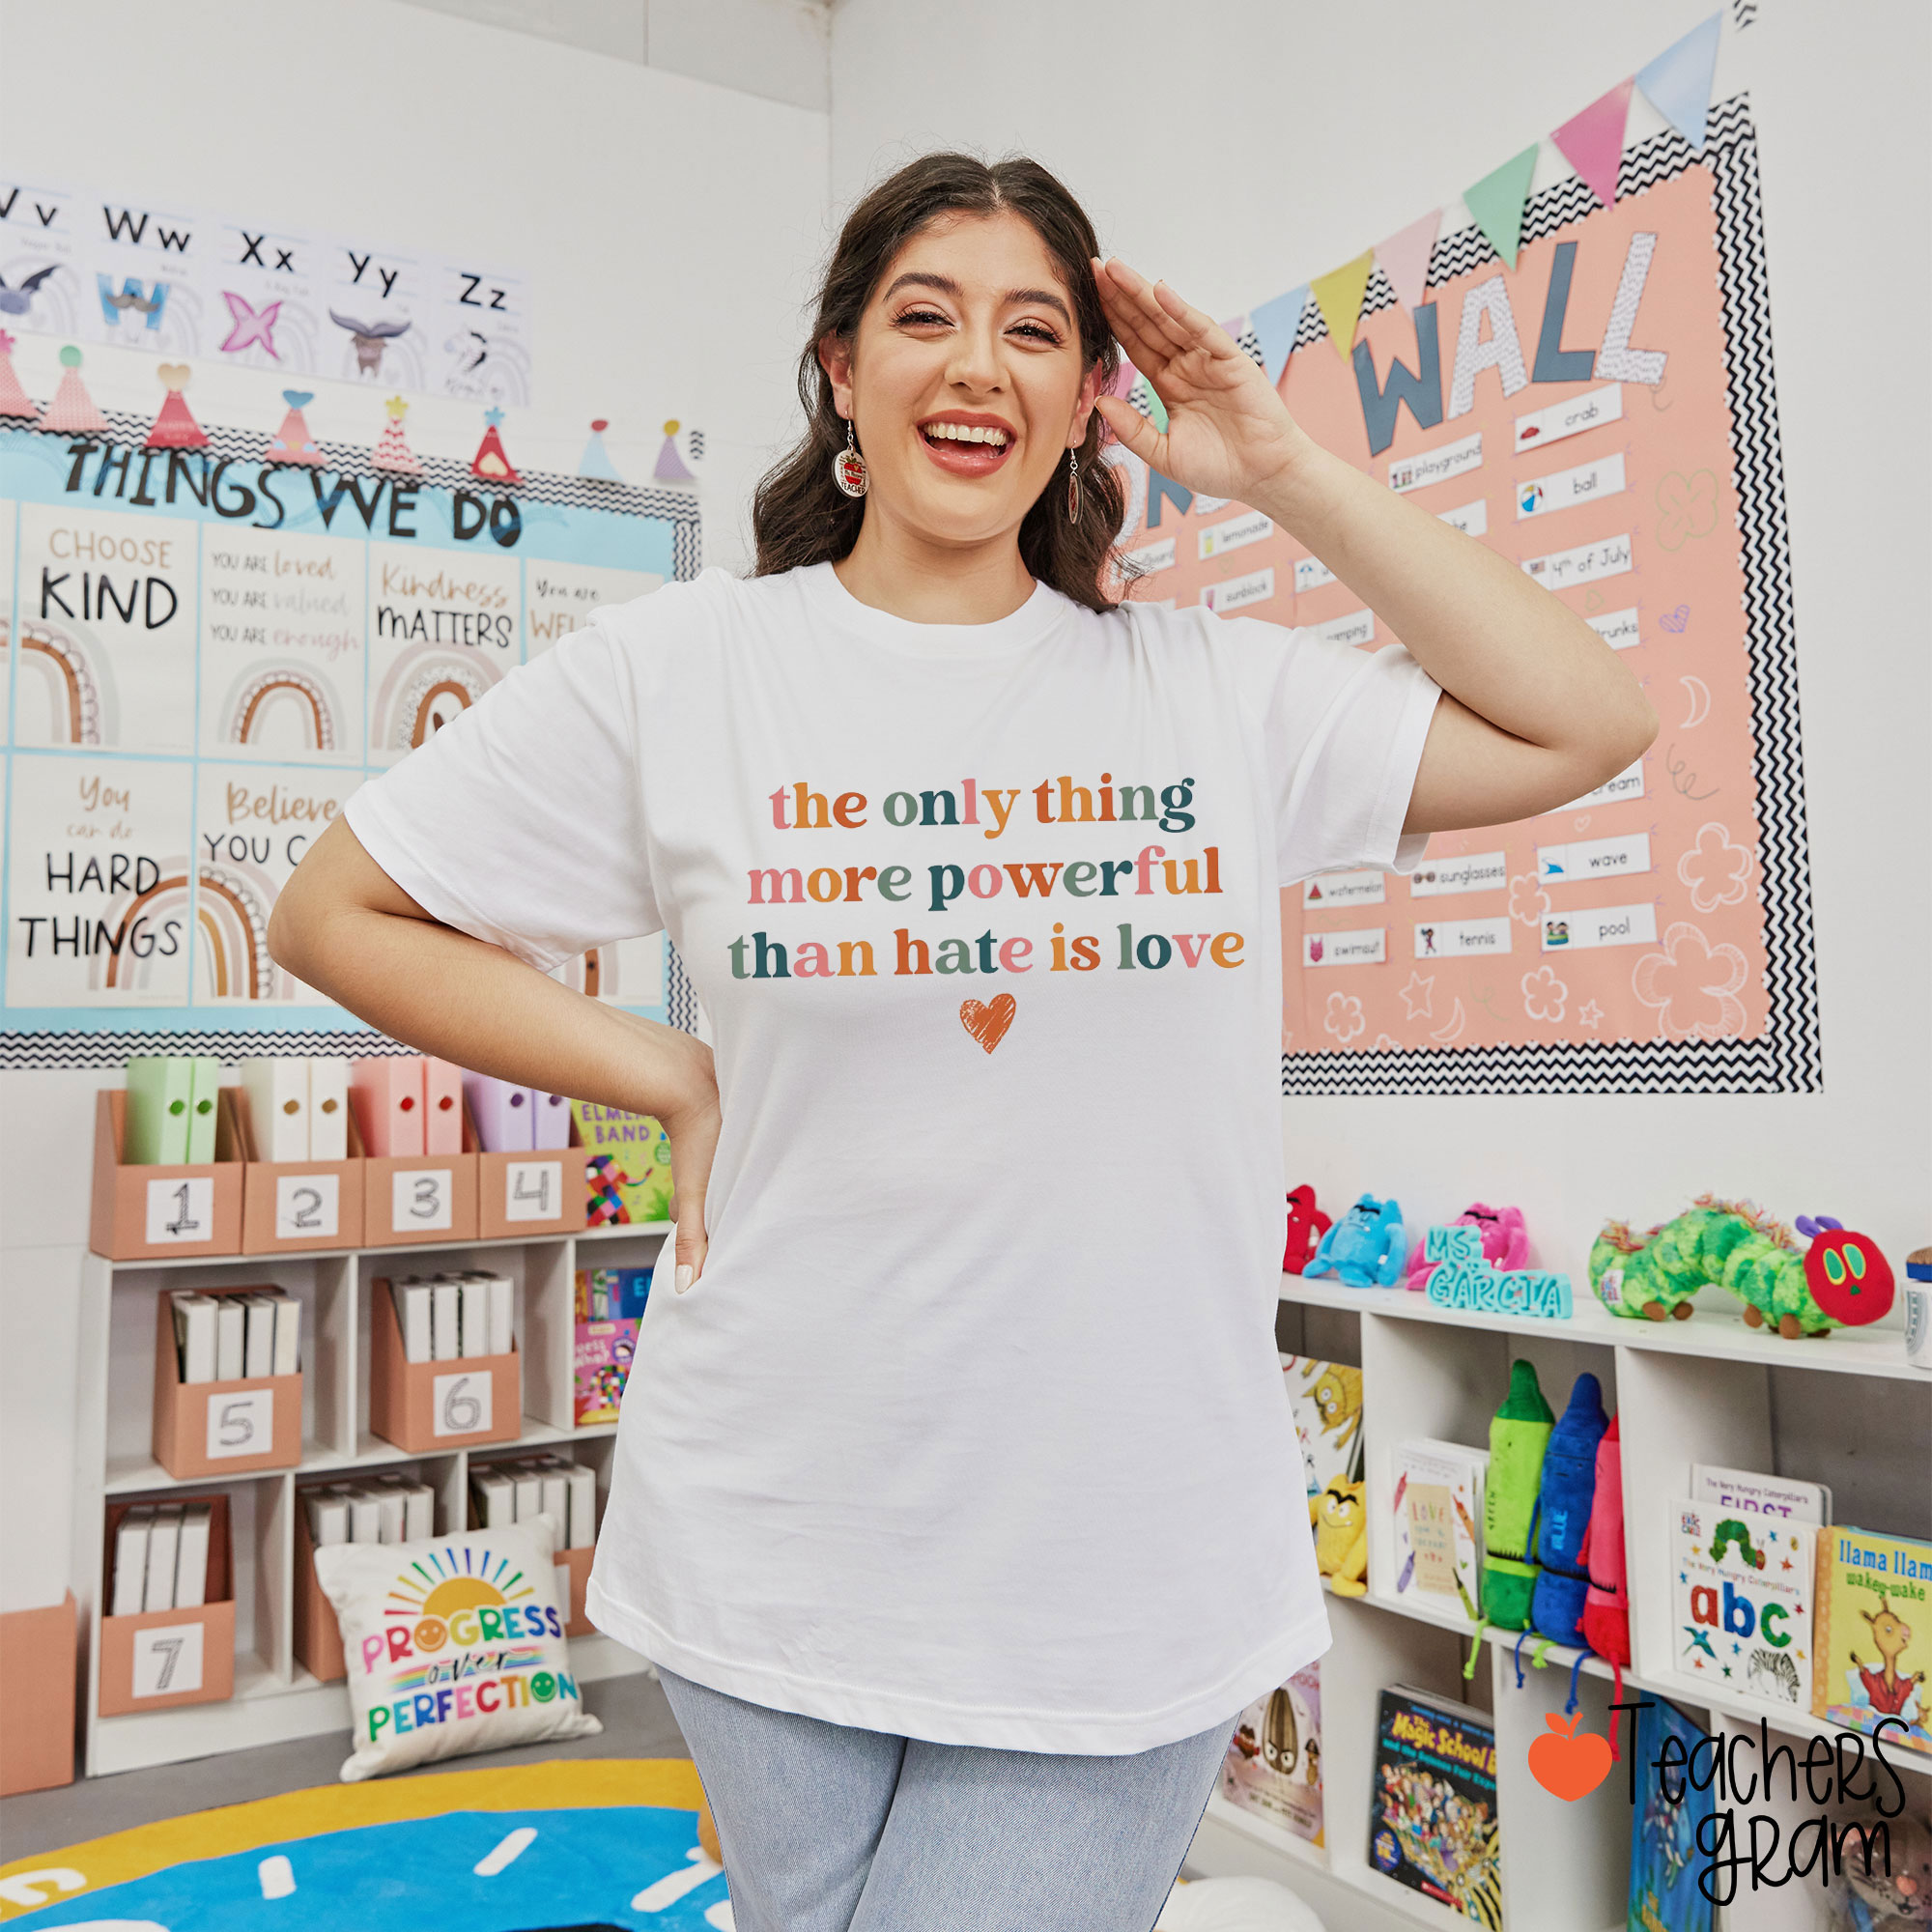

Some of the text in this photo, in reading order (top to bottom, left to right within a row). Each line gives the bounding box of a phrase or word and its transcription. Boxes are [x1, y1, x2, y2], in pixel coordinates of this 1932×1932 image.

[1352, 232, 1668, 457] WALL
[1565, 401, 1599, 426] crab
[1415, 439, 1482, 478] playground
[66, 442, 522, 548] THINGS WE DO
[841, 481, 867, 495] TEACHER
[1573, 472, 1598, 494] ball
[49, 529, 173, 569] CHOOSE
[1223, 520, 1269, 544] lemonade
[212, 549, 335, 580] YOU ARE loved
[1577, 553, 1594, 572] of
[1601, 546, 1631, 566] July
[42, 566, 178, 629] KIND
[212, 587, 240, 606] YOU
[243, 590, 267, 609] ARE
[382, 563, 509, 609] Kindness
[1226, 581, 1267, 603] sunblock
[211, 623, 239, 642] YOU
[242, 627, 267, 645] ARE
[378, 605, 512, 648] MATTERS
[80, 776, 130, 811] You
[226, 781, 337, 825] Believe
[769, 772, 1196, 839] the only thing
[67, 821, 132, 838] can do
[204, 834, 270, 863] YOU
[46, 852, 159, 895] HARD
[747, 844, 1223, 912] more powerful
[1439, 865, 1505, 885] sunglasses
[1589, 852, 1628, 867] wave
[1328, 880, 1383, 896] watermelon
[18, 916, 182, 958] THINGS
[1460, 930, 1495, 947] tennis
[1599, 916, 1631, 941] pool
[727, 922, 1245, 980] than hate is love
[595, 1124, 650, 1144] BAND
[166, 1182, 199, 1236] 1
[292, 1187, 323, 1229] 2
[410, 1177, 440, 1219] 3
[513, 1170, 549, 1212] 4
[1429, 1266, 1567, 1320] GARCIA
[219, 1401, 254, 1446] 5
[443, 1378, 481, 1431] 6
[1706, 1477, 1717, 1488] The
[1719, 1480, 1734, 1492] Very
[1737, 1484, 1761, 1496] Hungry
[1412, 1501, 1443, 1522] LOVE
[1550, 1509, 1568, 1550] BLUE
[1718, 1568, 1746, 1584] Hungry
[1839, 1539, 1932, 1582] llama llam
[1846, 1572, 1926, 1602] wakey-wake
[1690, 1580, 1792, 1648] abc
[362, 1605, 561, 1675] PROGRESS
[151, 1638, 184, 1690] 7
[428, 1649, 512, 1685] over
[368, 1671, 579, 1743] PERFECTION
[1392, 1711, 1436, 1748] Magic
[1436, 1727, 1488, 1771] School
